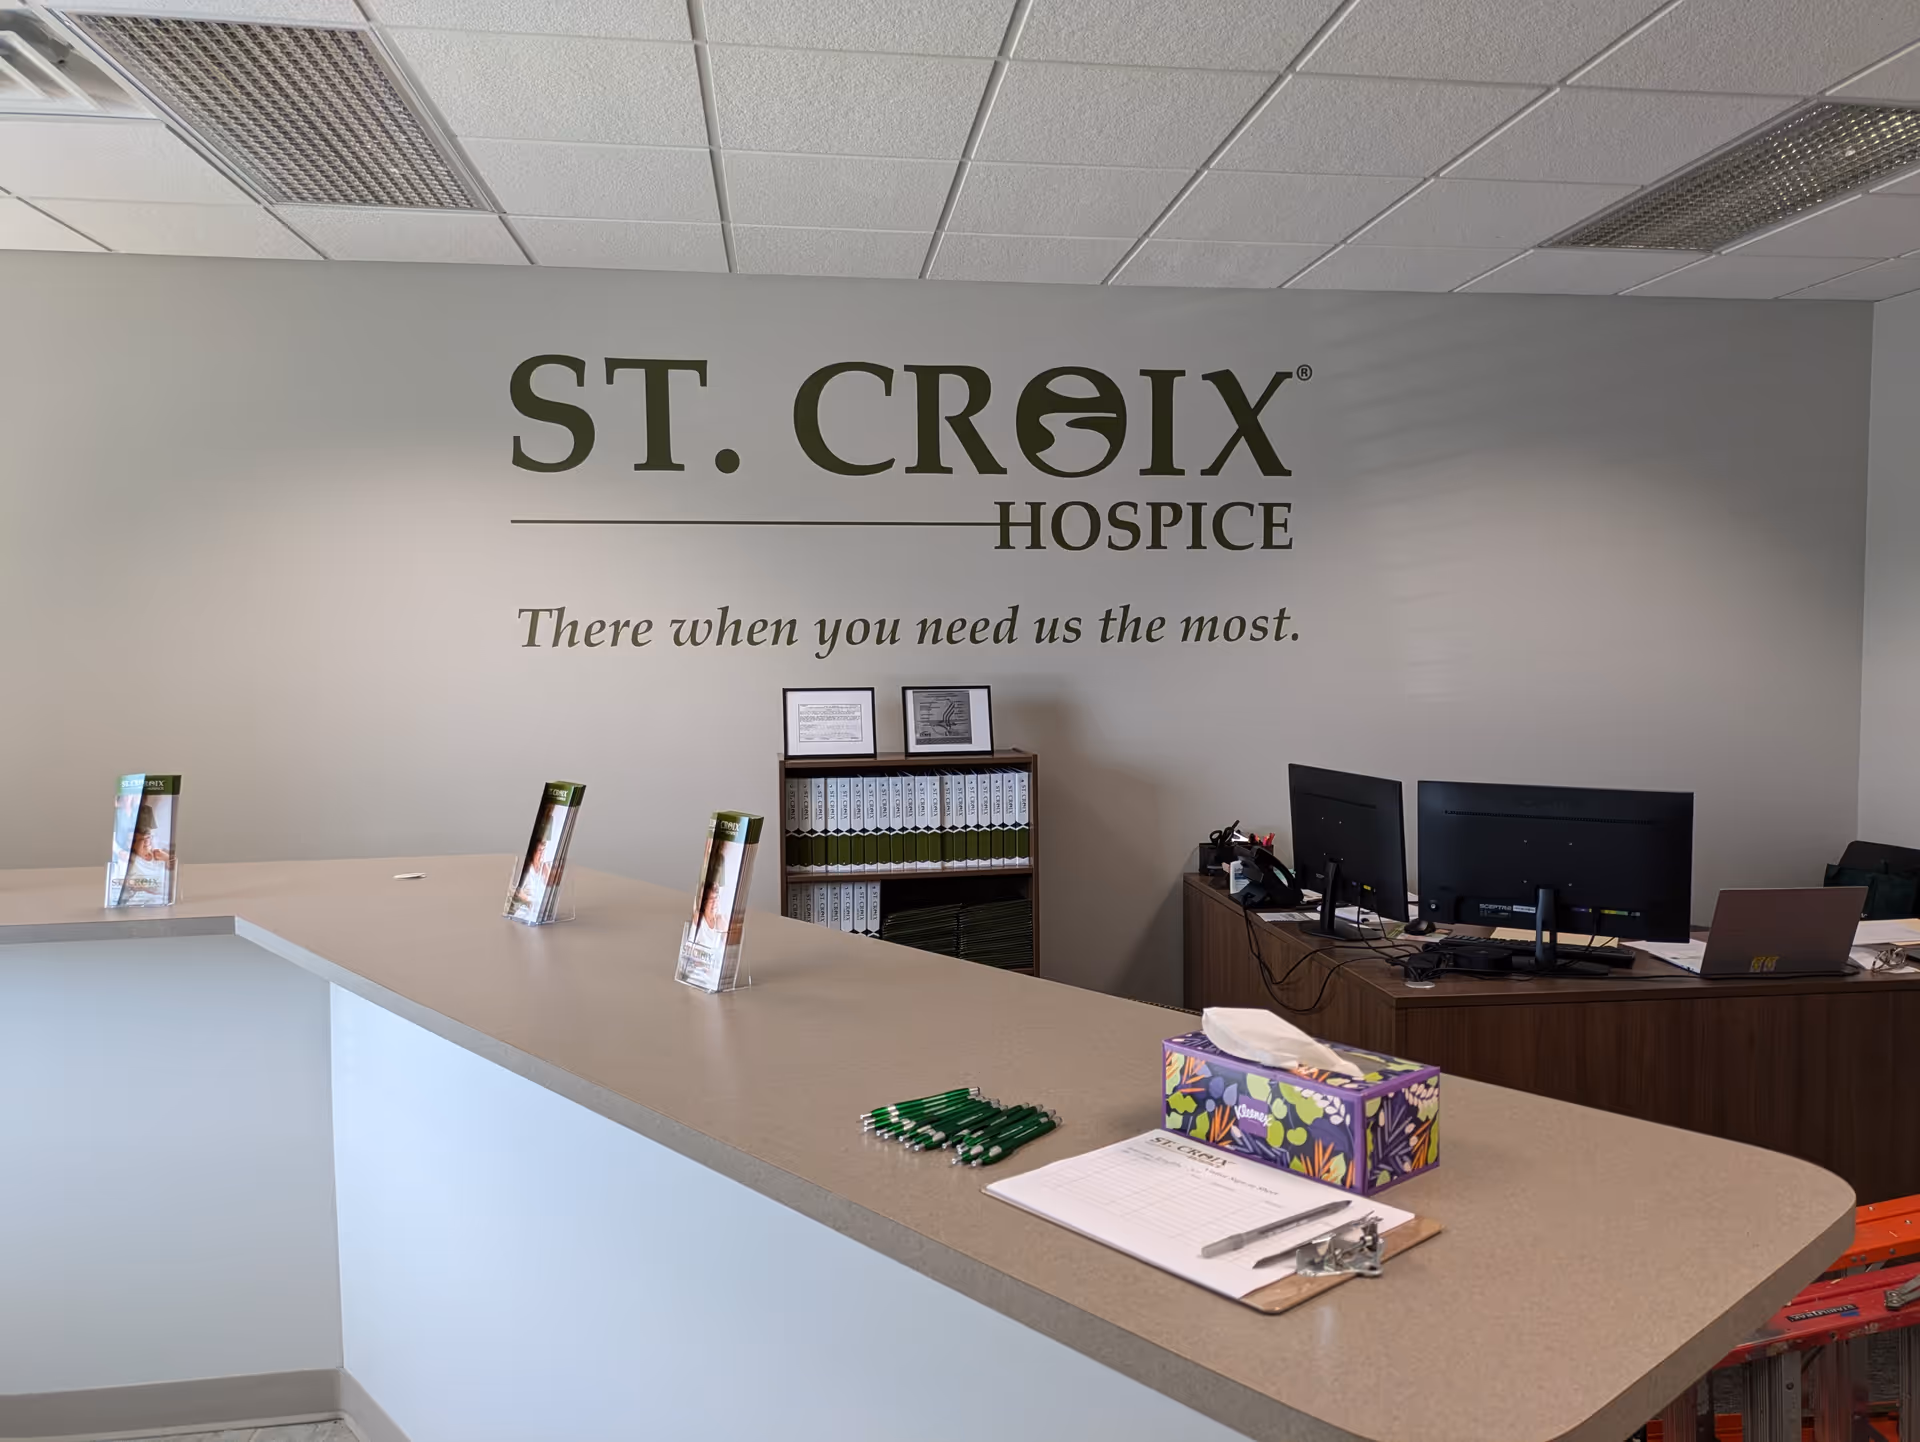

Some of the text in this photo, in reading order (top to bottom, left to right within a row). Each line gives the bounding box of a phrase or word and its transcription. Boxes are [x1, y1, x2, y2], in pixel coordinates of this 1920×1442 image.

[509, 354, 740, 474] ST.
[994, 500, 1293, 552] HOSPICE
[518, 603, 1299, 660] There when you need us the most.
[1234, 1104, 1272, 1127] Kleenex
